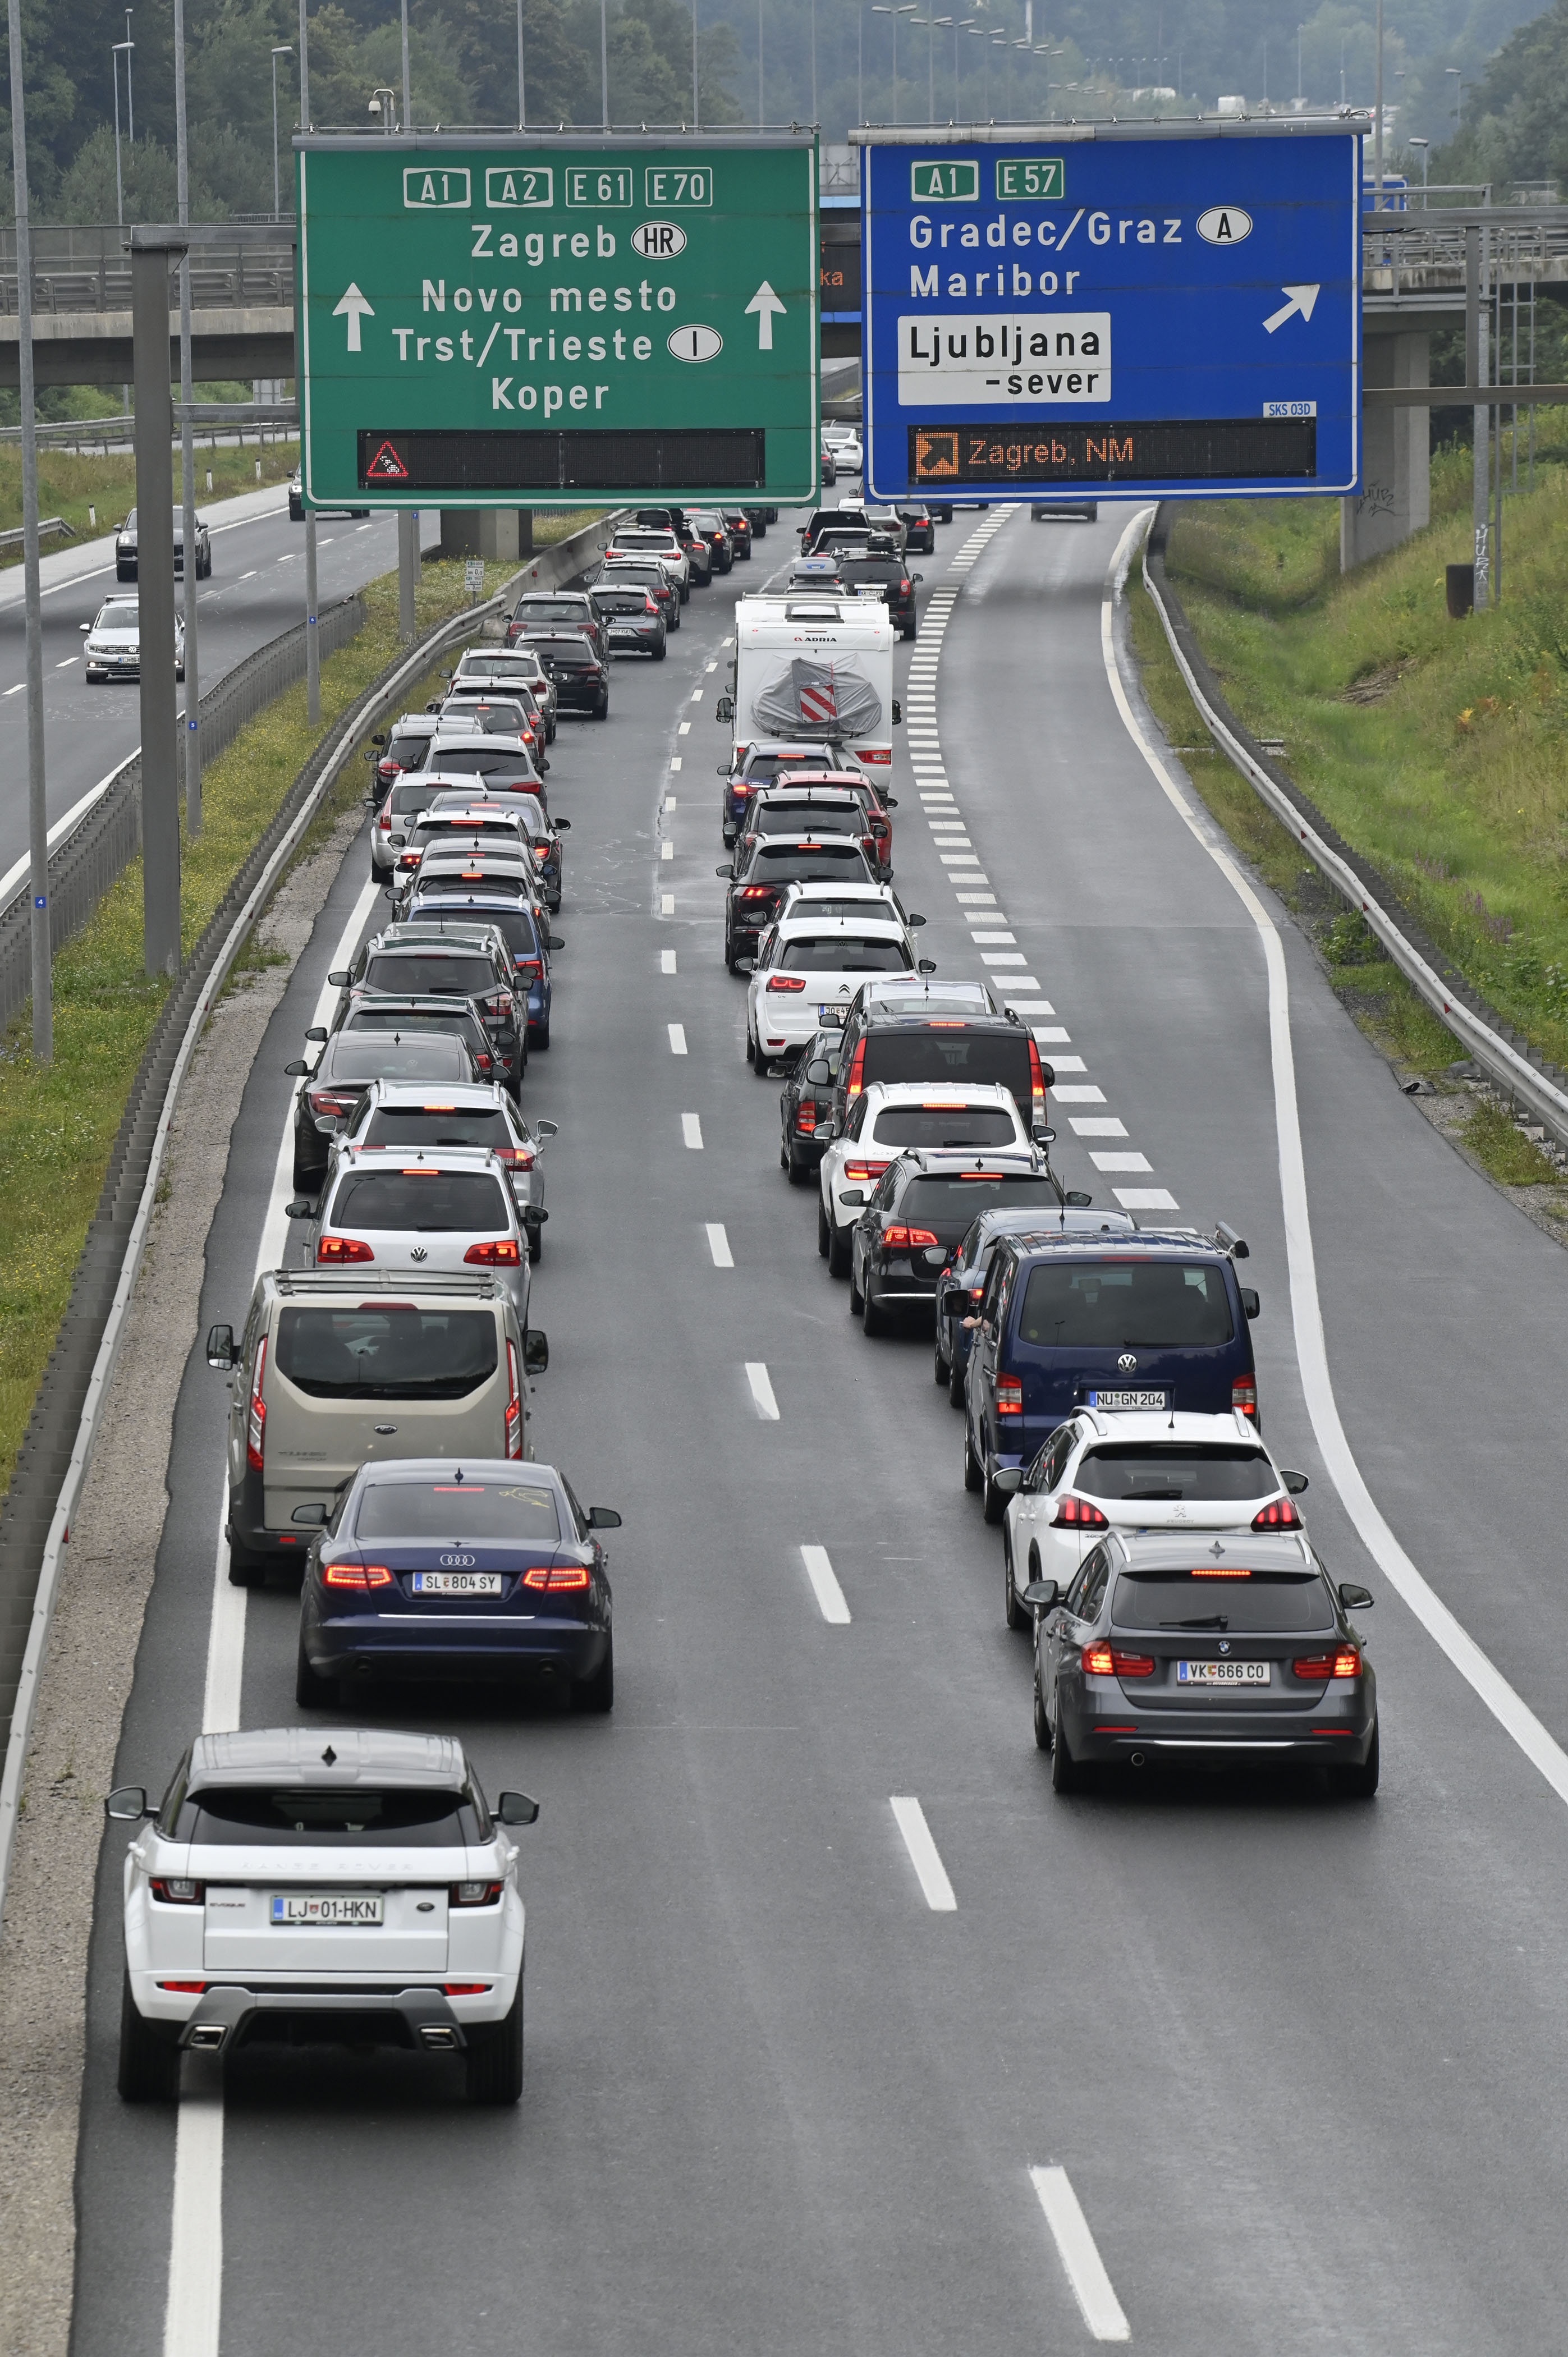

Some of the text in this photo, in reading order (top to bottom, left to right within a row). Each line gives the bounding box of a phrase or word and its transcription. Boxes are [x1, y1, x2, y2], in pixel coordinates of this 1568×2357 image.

[421, 173, 449, 201] A1
[502, 173, 537, 201] A2
[929, 167, 957, 195] A1
[910, 209, 1231, 250] Gradec/Graz A
[472, 225, 673, 266] Zagreb HR
[423, 279, 675, 312] Novo mesto
[911, 264, 1079, 297] Maribor
[392, 323, 697, 367] Trst/Trieste I
[911, 325, 1099, 367] Ljubljana
[493, 378, 609, 418] Koper
[986, 371, 1098, 395] -sever
[1269, 403, 1287, 415] SKS
[969, 438, 1133, 470] Zagreb, NM
[1097, 1393, 1113, 1405] NU
[1121, 1393, 1138, 1405] GN
[1140, 1393, 1163, 1405] 204
[426, 1576, 441, 1589] SL
[452, 1576, 476, 1589] 804
[479, 1577, 495, 1589] SY
[1190, 1664, 1206, 1678] VK
[1218, 1664, 1243, 1678] 666
[288, 1901, 377, 1918] LJ 01-HKN
